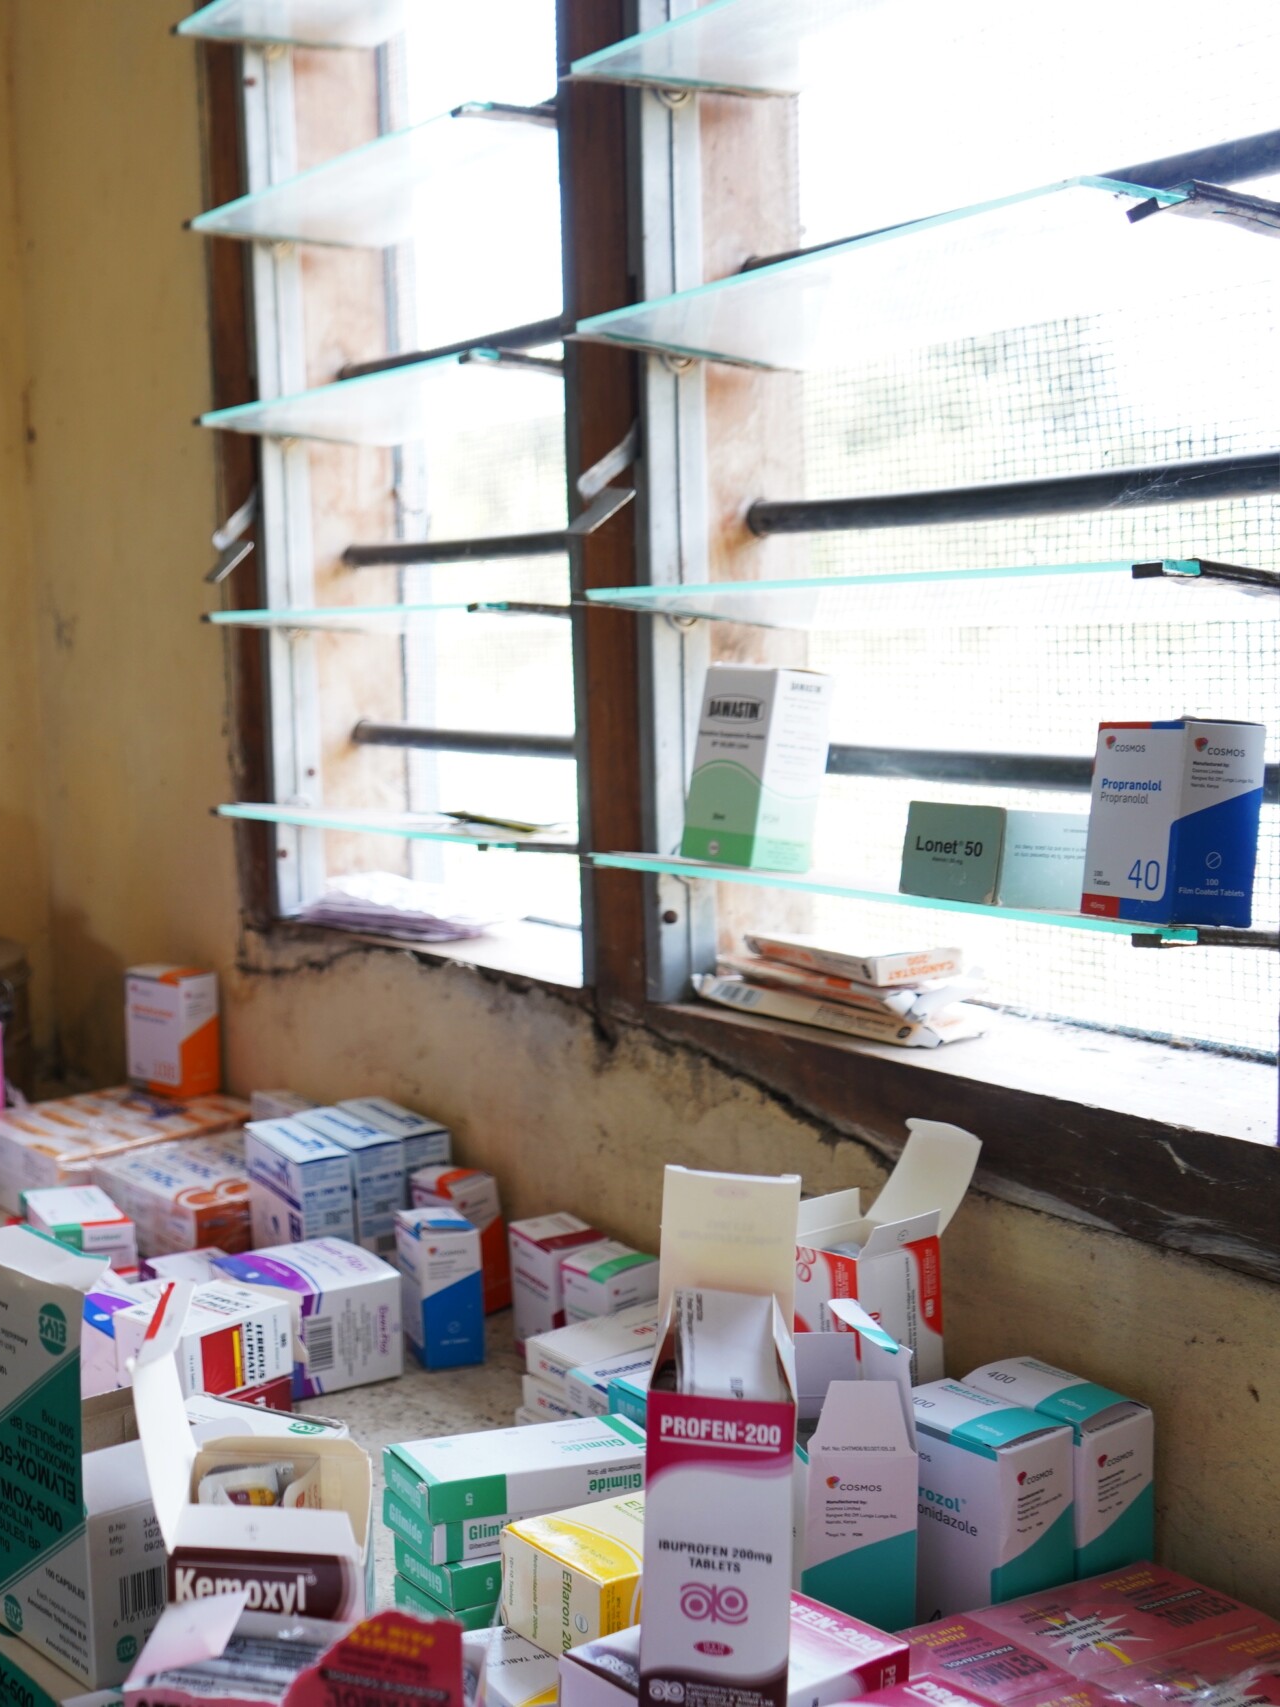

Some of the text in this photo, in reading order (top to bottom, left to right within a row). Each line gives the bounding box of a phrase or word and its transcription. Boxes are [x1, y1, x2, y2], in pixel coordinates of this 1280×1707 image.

[1115, 744, 1146, 753] COSMOS
[1207, 747, 1246, 757] COSMOS
[1101, 778, 1162, 792] Propranolol
[1100, 792, 1149, 805] Propranolol
[964, 840, 983, 857] 50
[1127, 859, 1160, 891] 40
[1205, 878, 1219, 886] 100
[1178, 886, 1245, 897] Film Coated Tablets
[887, 960, 955, 980] CANDISTAT
[38, 1314, 67, 1345] ELYS
[246, 1321, 255, 1381] SULPHATE
[256, 1324, 266, 1379] FERROUS
[986, 1371, 1017, 1385] 400
[660, 1414, 781, 1446] PROFEN-200
[1106, 1450, 1135, 1467] COSMOS
[589, 1472, 642, 1495] Glimide
[1026, 1468, 1054, 1485] COSMOS
[840, 1484, 882, 1492] COSMOS
[465, 1492, 474, 1506] 5
[918, 1486, 961, 1513] rozol
[388, 1503, 424, 1545] Glimide
[469, 1515, 511, 1541] Glimi
[917, 1502, 978, 1538] onidazole
[658, 1539, 773, 1564] IBUPROFEN 200mg
[403, 1552, 442, 1594] Glimide
[689, 1557, 741, 1574] TABLETS
[55, 1573, 86, 1601] CAPSULES
[486, 1576, 494, 1591] 5
[561, 1570, 572, 1627] Eflaron
[1135, 1589, 1201, 1612] PARACETAMOL
[790, 1603, 886, 1651] FEN-200
[939, 1624, 966, 1635] PAIN
[1076, 1630, 1100, 1640] from
[926, 1632, 967, 1647] FIGHTS
[943, 1645, 1014, 1668] PARACETAMOL
